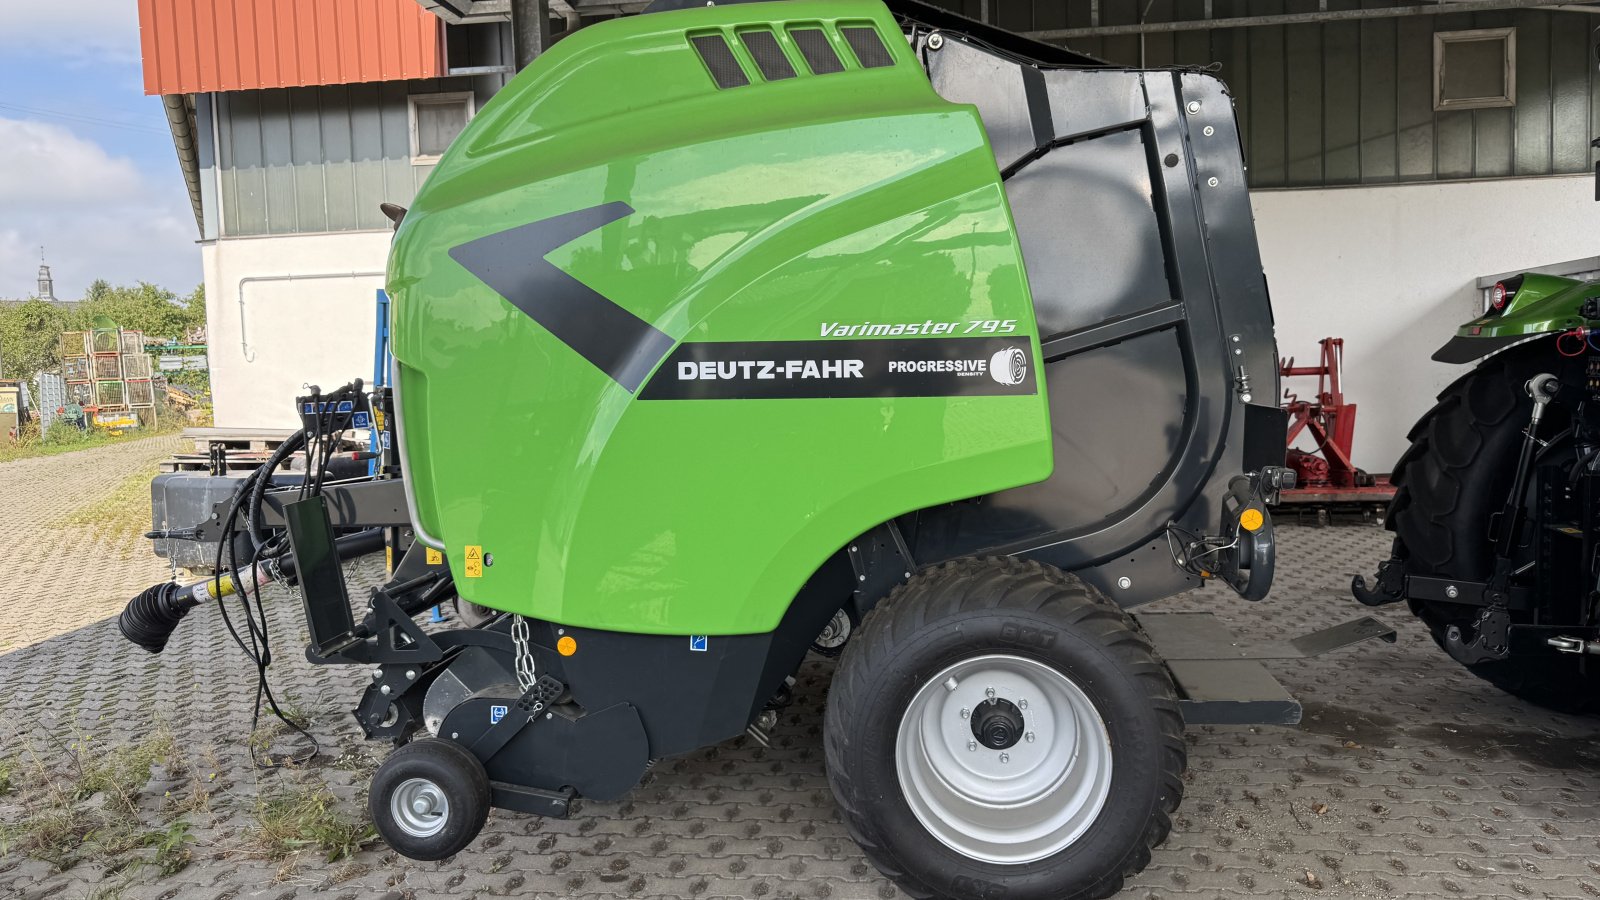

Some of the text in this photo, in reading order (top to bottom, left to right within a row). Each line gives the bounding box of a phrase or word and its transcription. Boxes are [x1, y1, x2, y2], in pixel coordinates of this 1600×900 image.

[820, 319, 1018, 337] Varimaster 795
[677, 359, 865, 380] DEUTZ-FAHR
[888, 360, 987, 373] PROGRESSIVE
